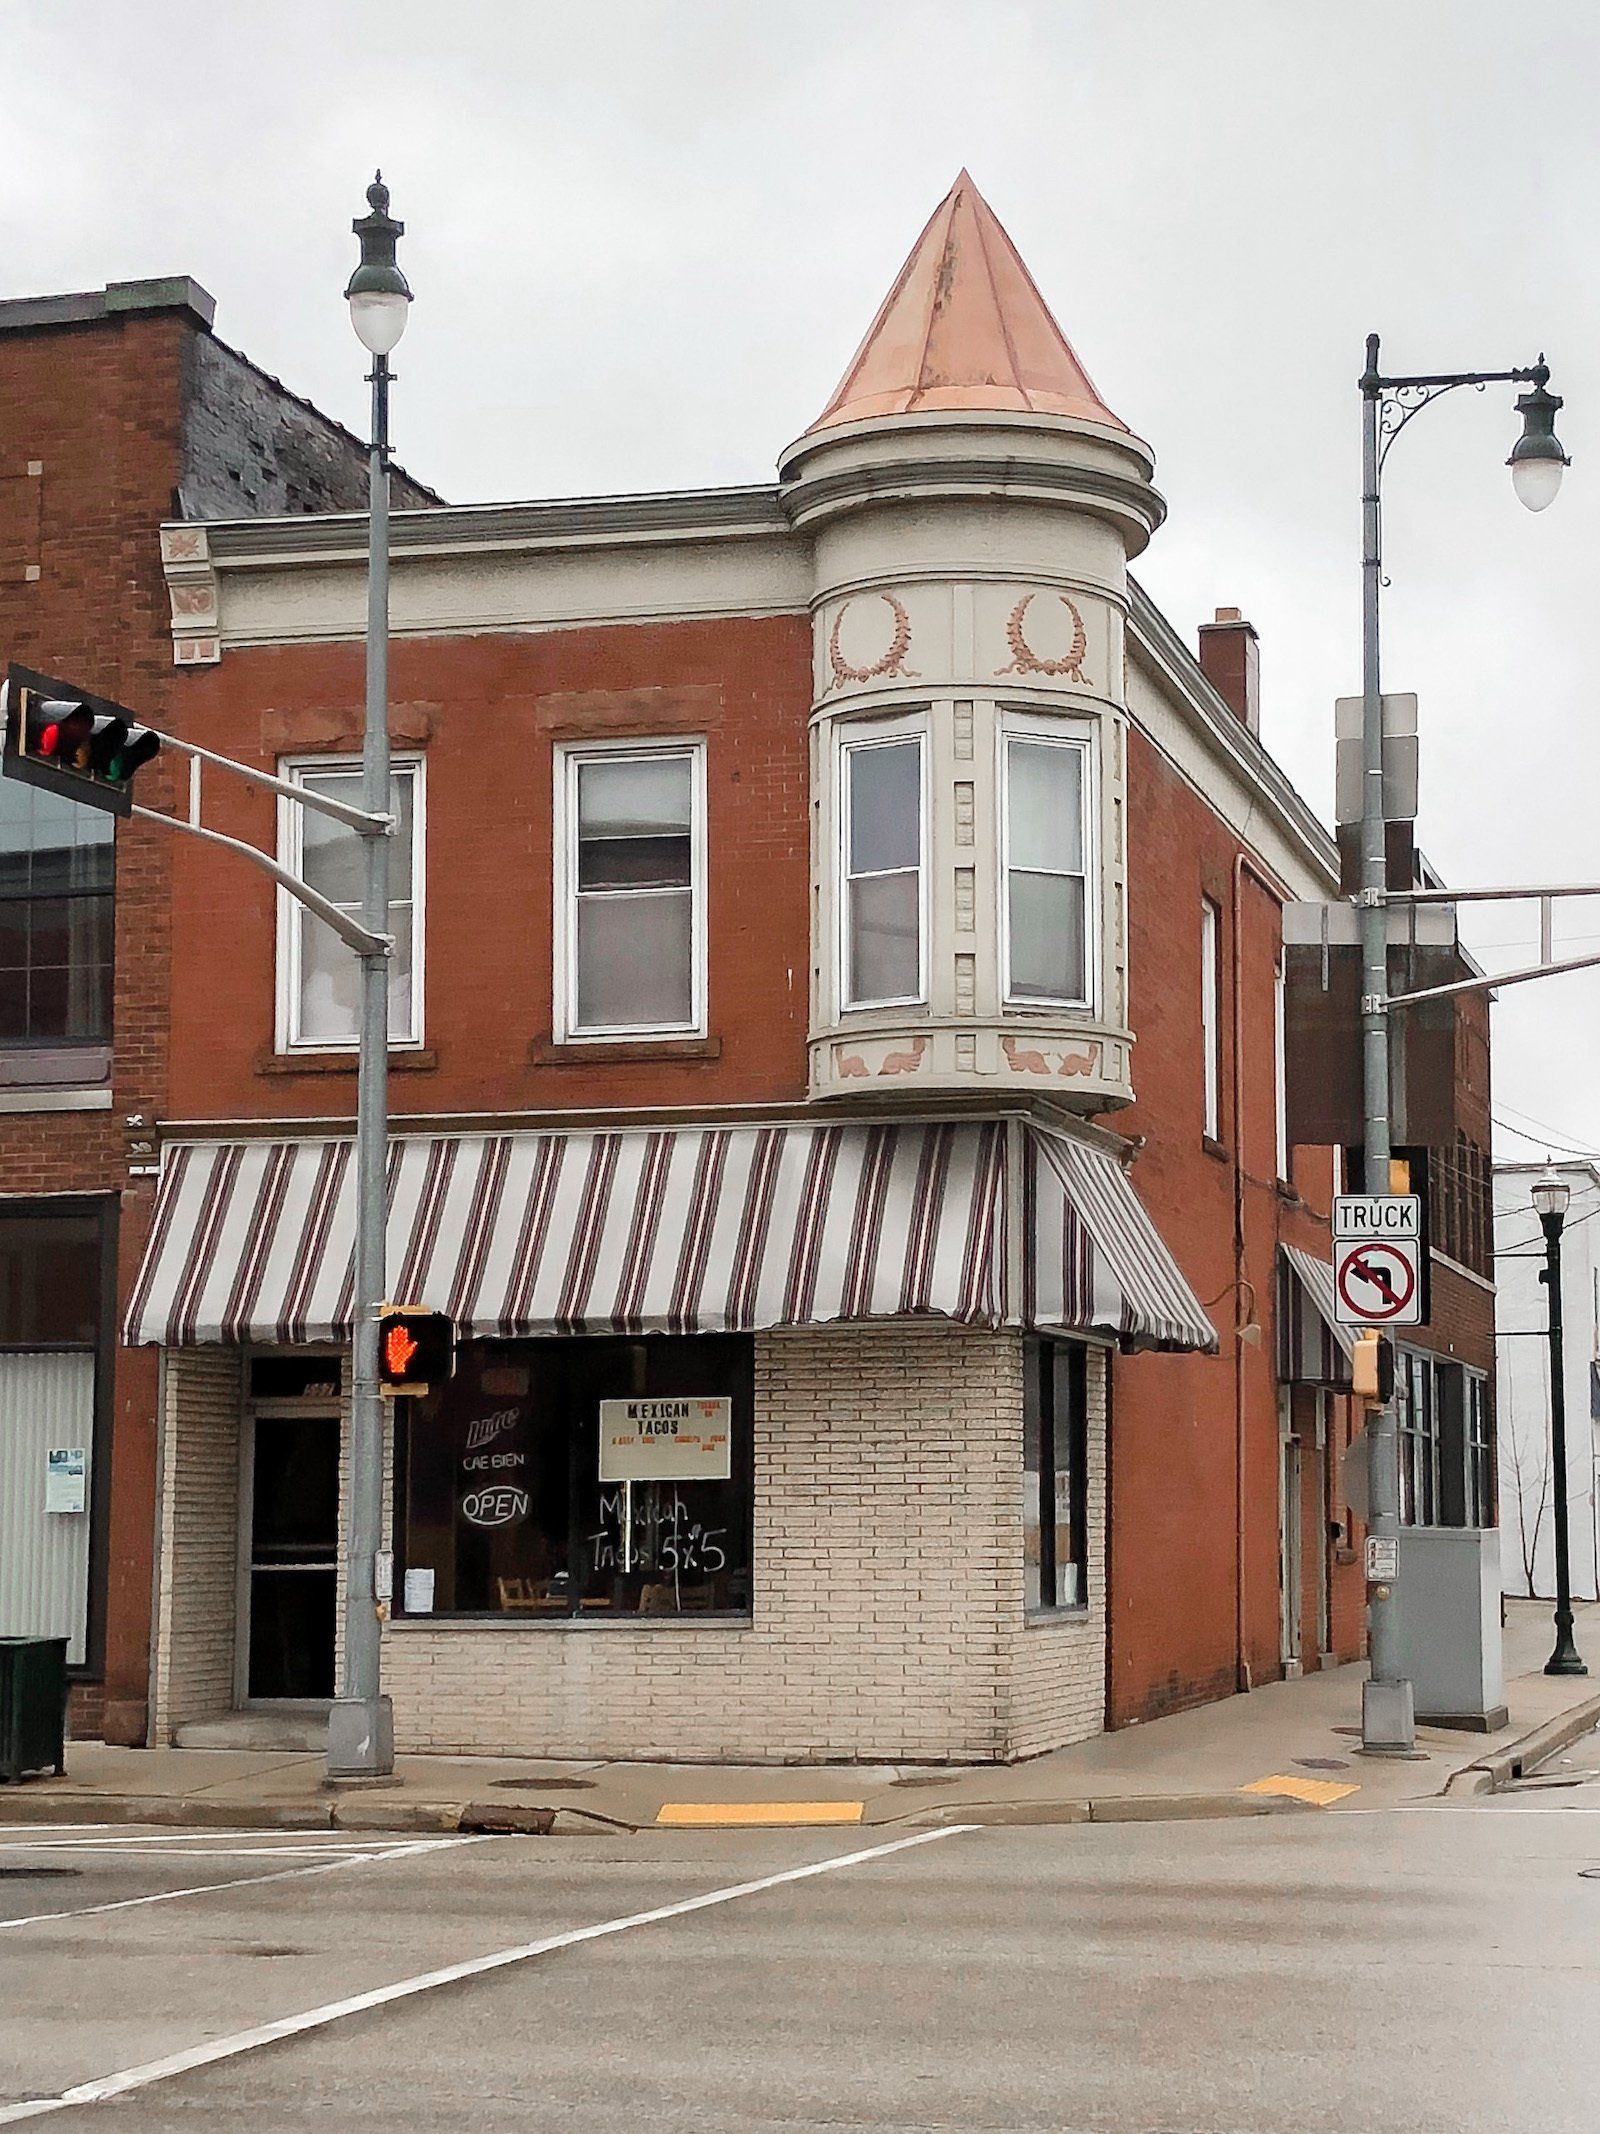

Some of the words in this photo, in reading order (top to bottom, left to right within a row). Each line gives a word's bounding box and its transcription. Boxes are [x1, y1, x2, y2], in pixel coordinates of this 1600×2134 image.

[1340, 1205, 1412, 1228] TRUCK
[627, 1402, 690, 1419] MEXICAN
[637, 1419, 679, 1435] TACOS
[462, 1456, 489, 1471] CAE
[491, 1453, 525, 1468] BIEN
[463, 1493, 529, 1517] OPEN
[600, 1491, 688, 1526] Mxican
